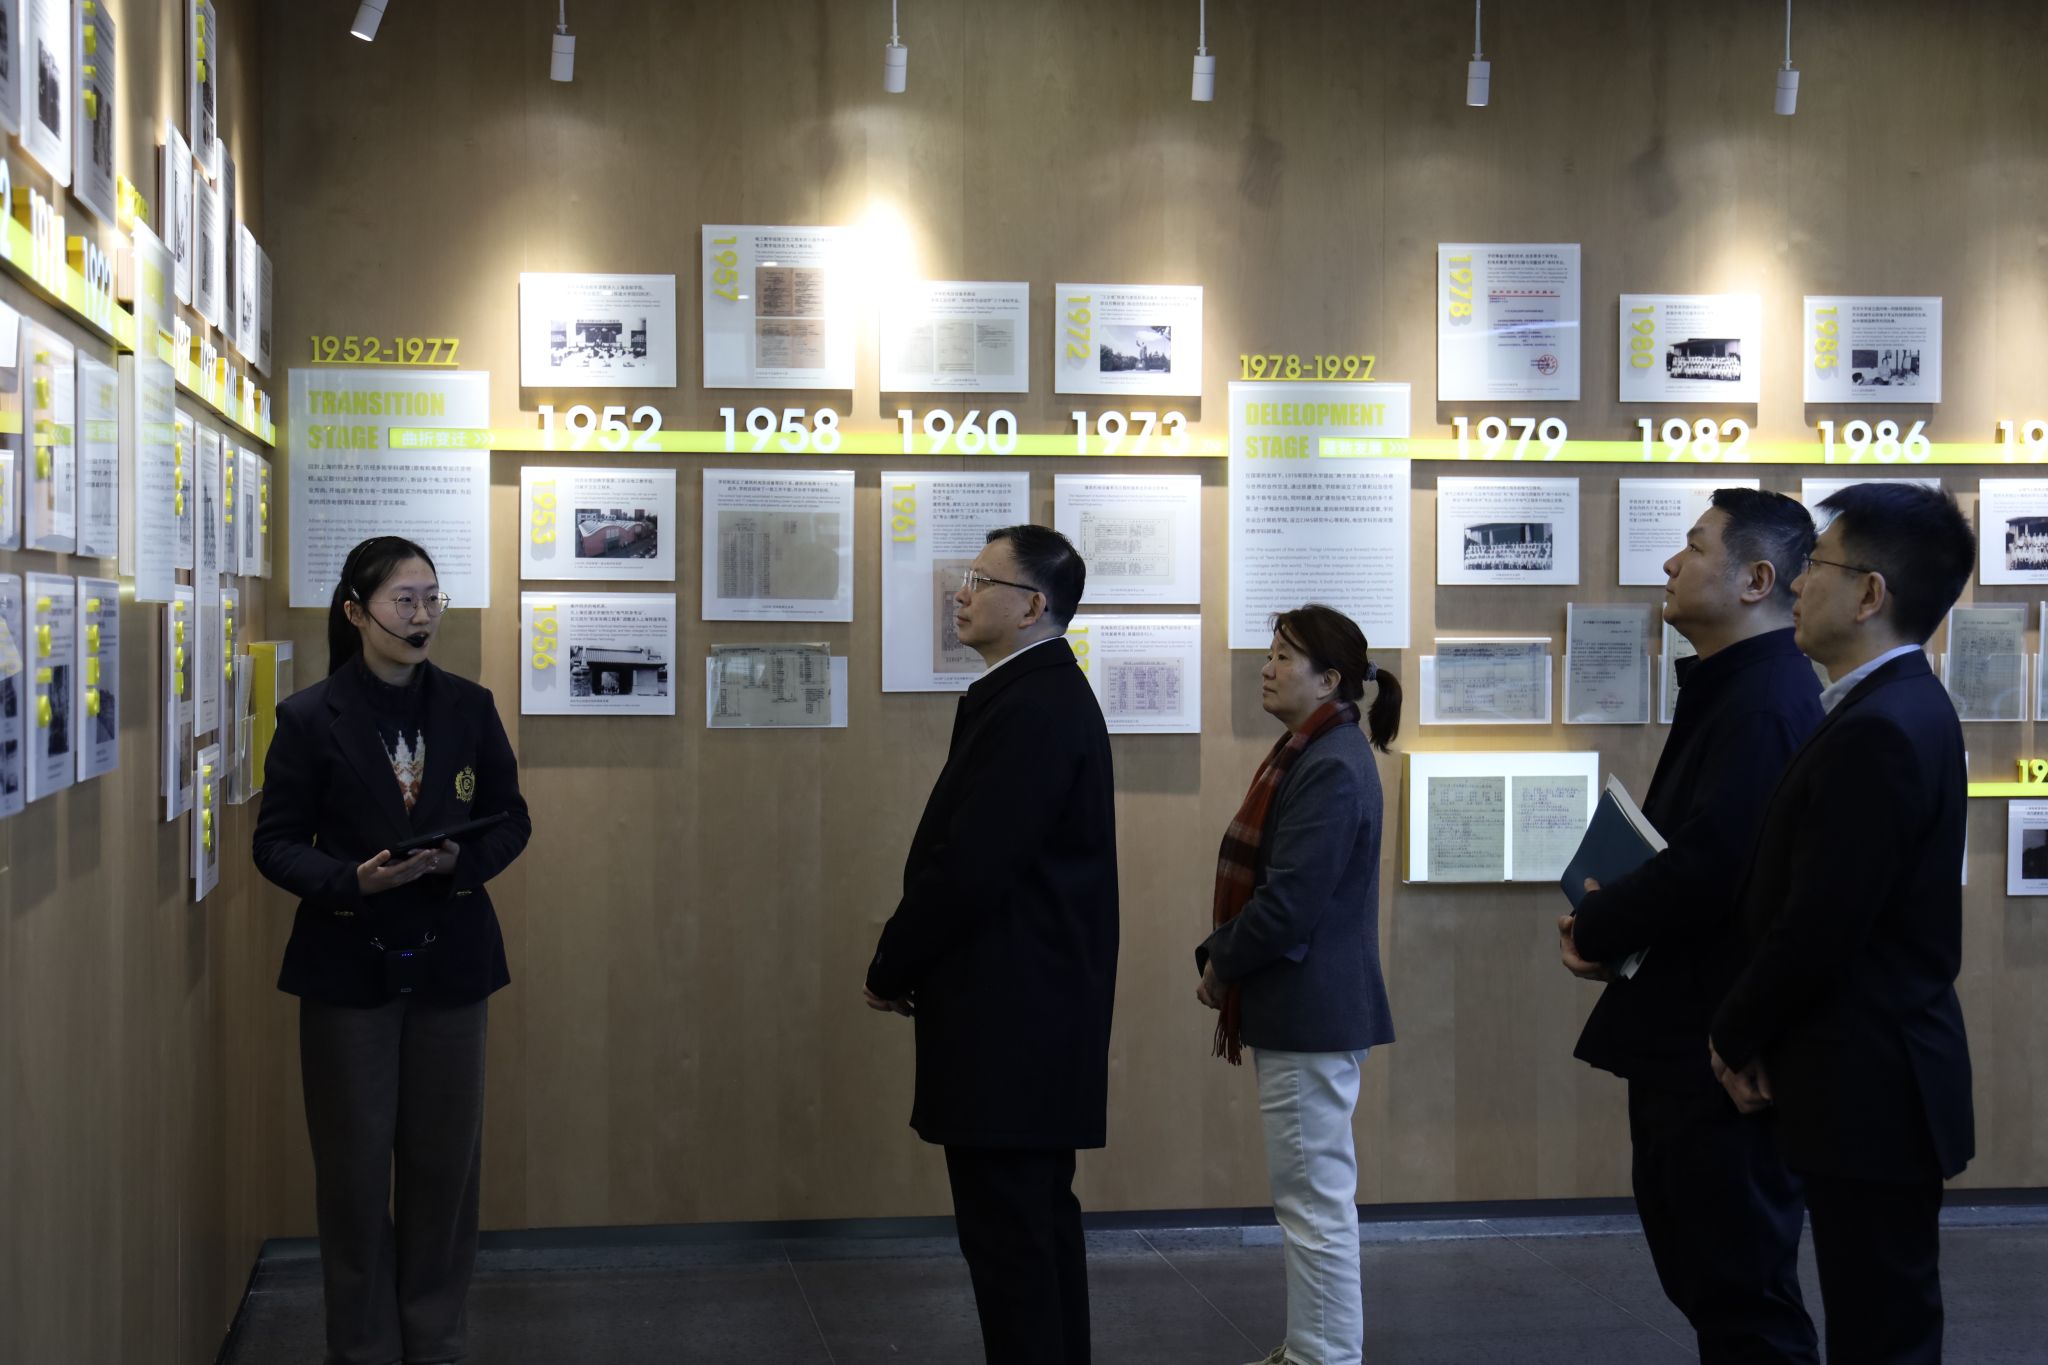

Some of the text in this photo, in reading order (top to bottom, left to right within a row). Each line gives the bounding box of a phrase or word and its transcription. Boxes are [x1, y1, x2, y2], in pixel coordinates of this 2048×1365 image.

[82, 236, 112, 335] 1922
[713, 235, 738, 302] 1957
[1449, 254, 1473, 318] 1978
[311, 335, 460, 365] 1952-1977
[1067, 295, 1091, 360] 1972
[1631, 305, 1655, 369] 1980
[1815, 306, 1839, 369] 1985
[1240, 354, 1376, 380] 1978-1997
[307, 390, 446, 417] TRANSITION
[307, 425, 379, 450] STAGE
[538, 405, 663, 452] 1952
[719, 407, 841, 453] 1958
[897, 409, 1018, 455] 1960
[1071, 410, 1191, 455] 1973
[1245, 435, 1310, 459] STAGE
[1451, 416, 1568, 460] 1979
[1636, 417, 1751, 462] 1982
[1816, 419, 1932, 463] 1986
[530, 479, 557, 545] 1953
[892, 483, 917, 543] 1961
[532, 604, 558, 671] 1956
